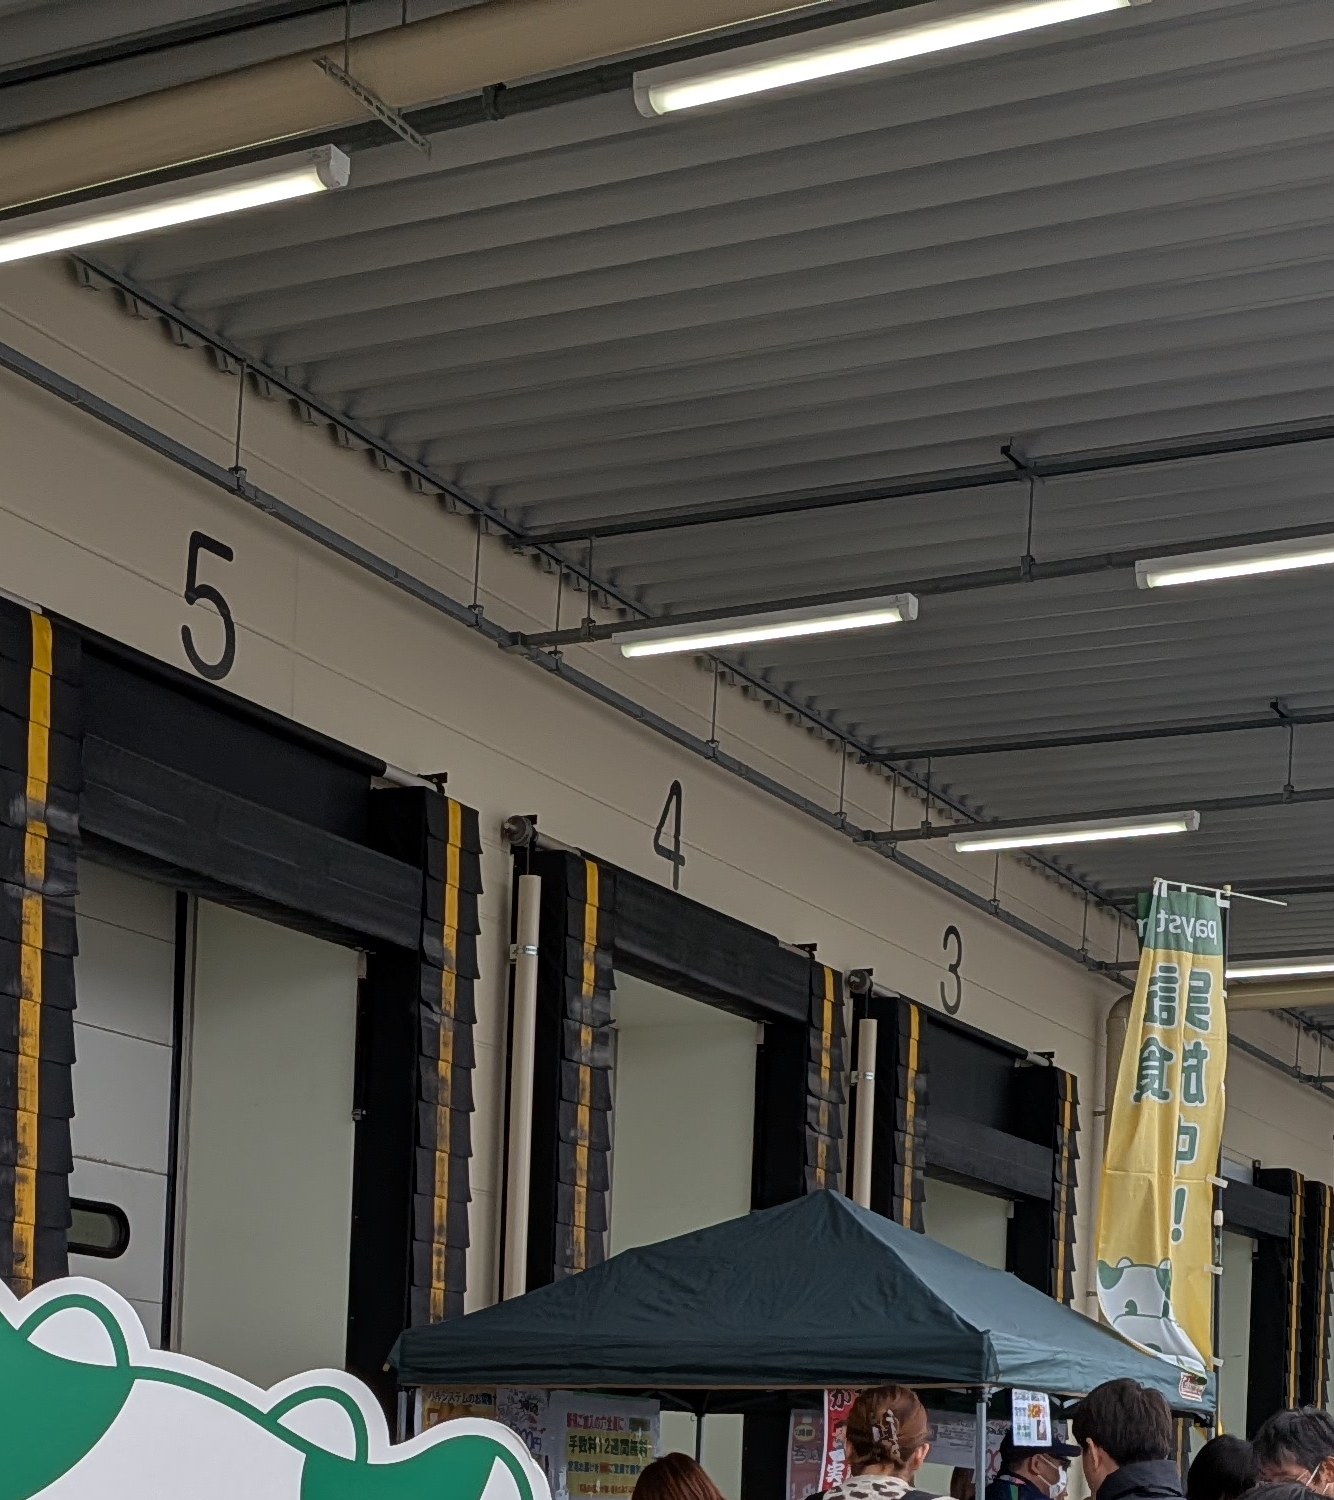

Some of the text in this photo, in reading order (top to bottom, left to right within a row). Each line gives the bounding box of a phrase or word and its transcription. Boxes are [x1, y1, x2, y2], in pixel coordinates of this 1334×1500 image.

[181, 530, 236, 681] 5
[653, 779, 685, 890] 4
[940, 925, 962, 1015] 3
[568, 1434, 648, 1458] 手数料12週間無料
